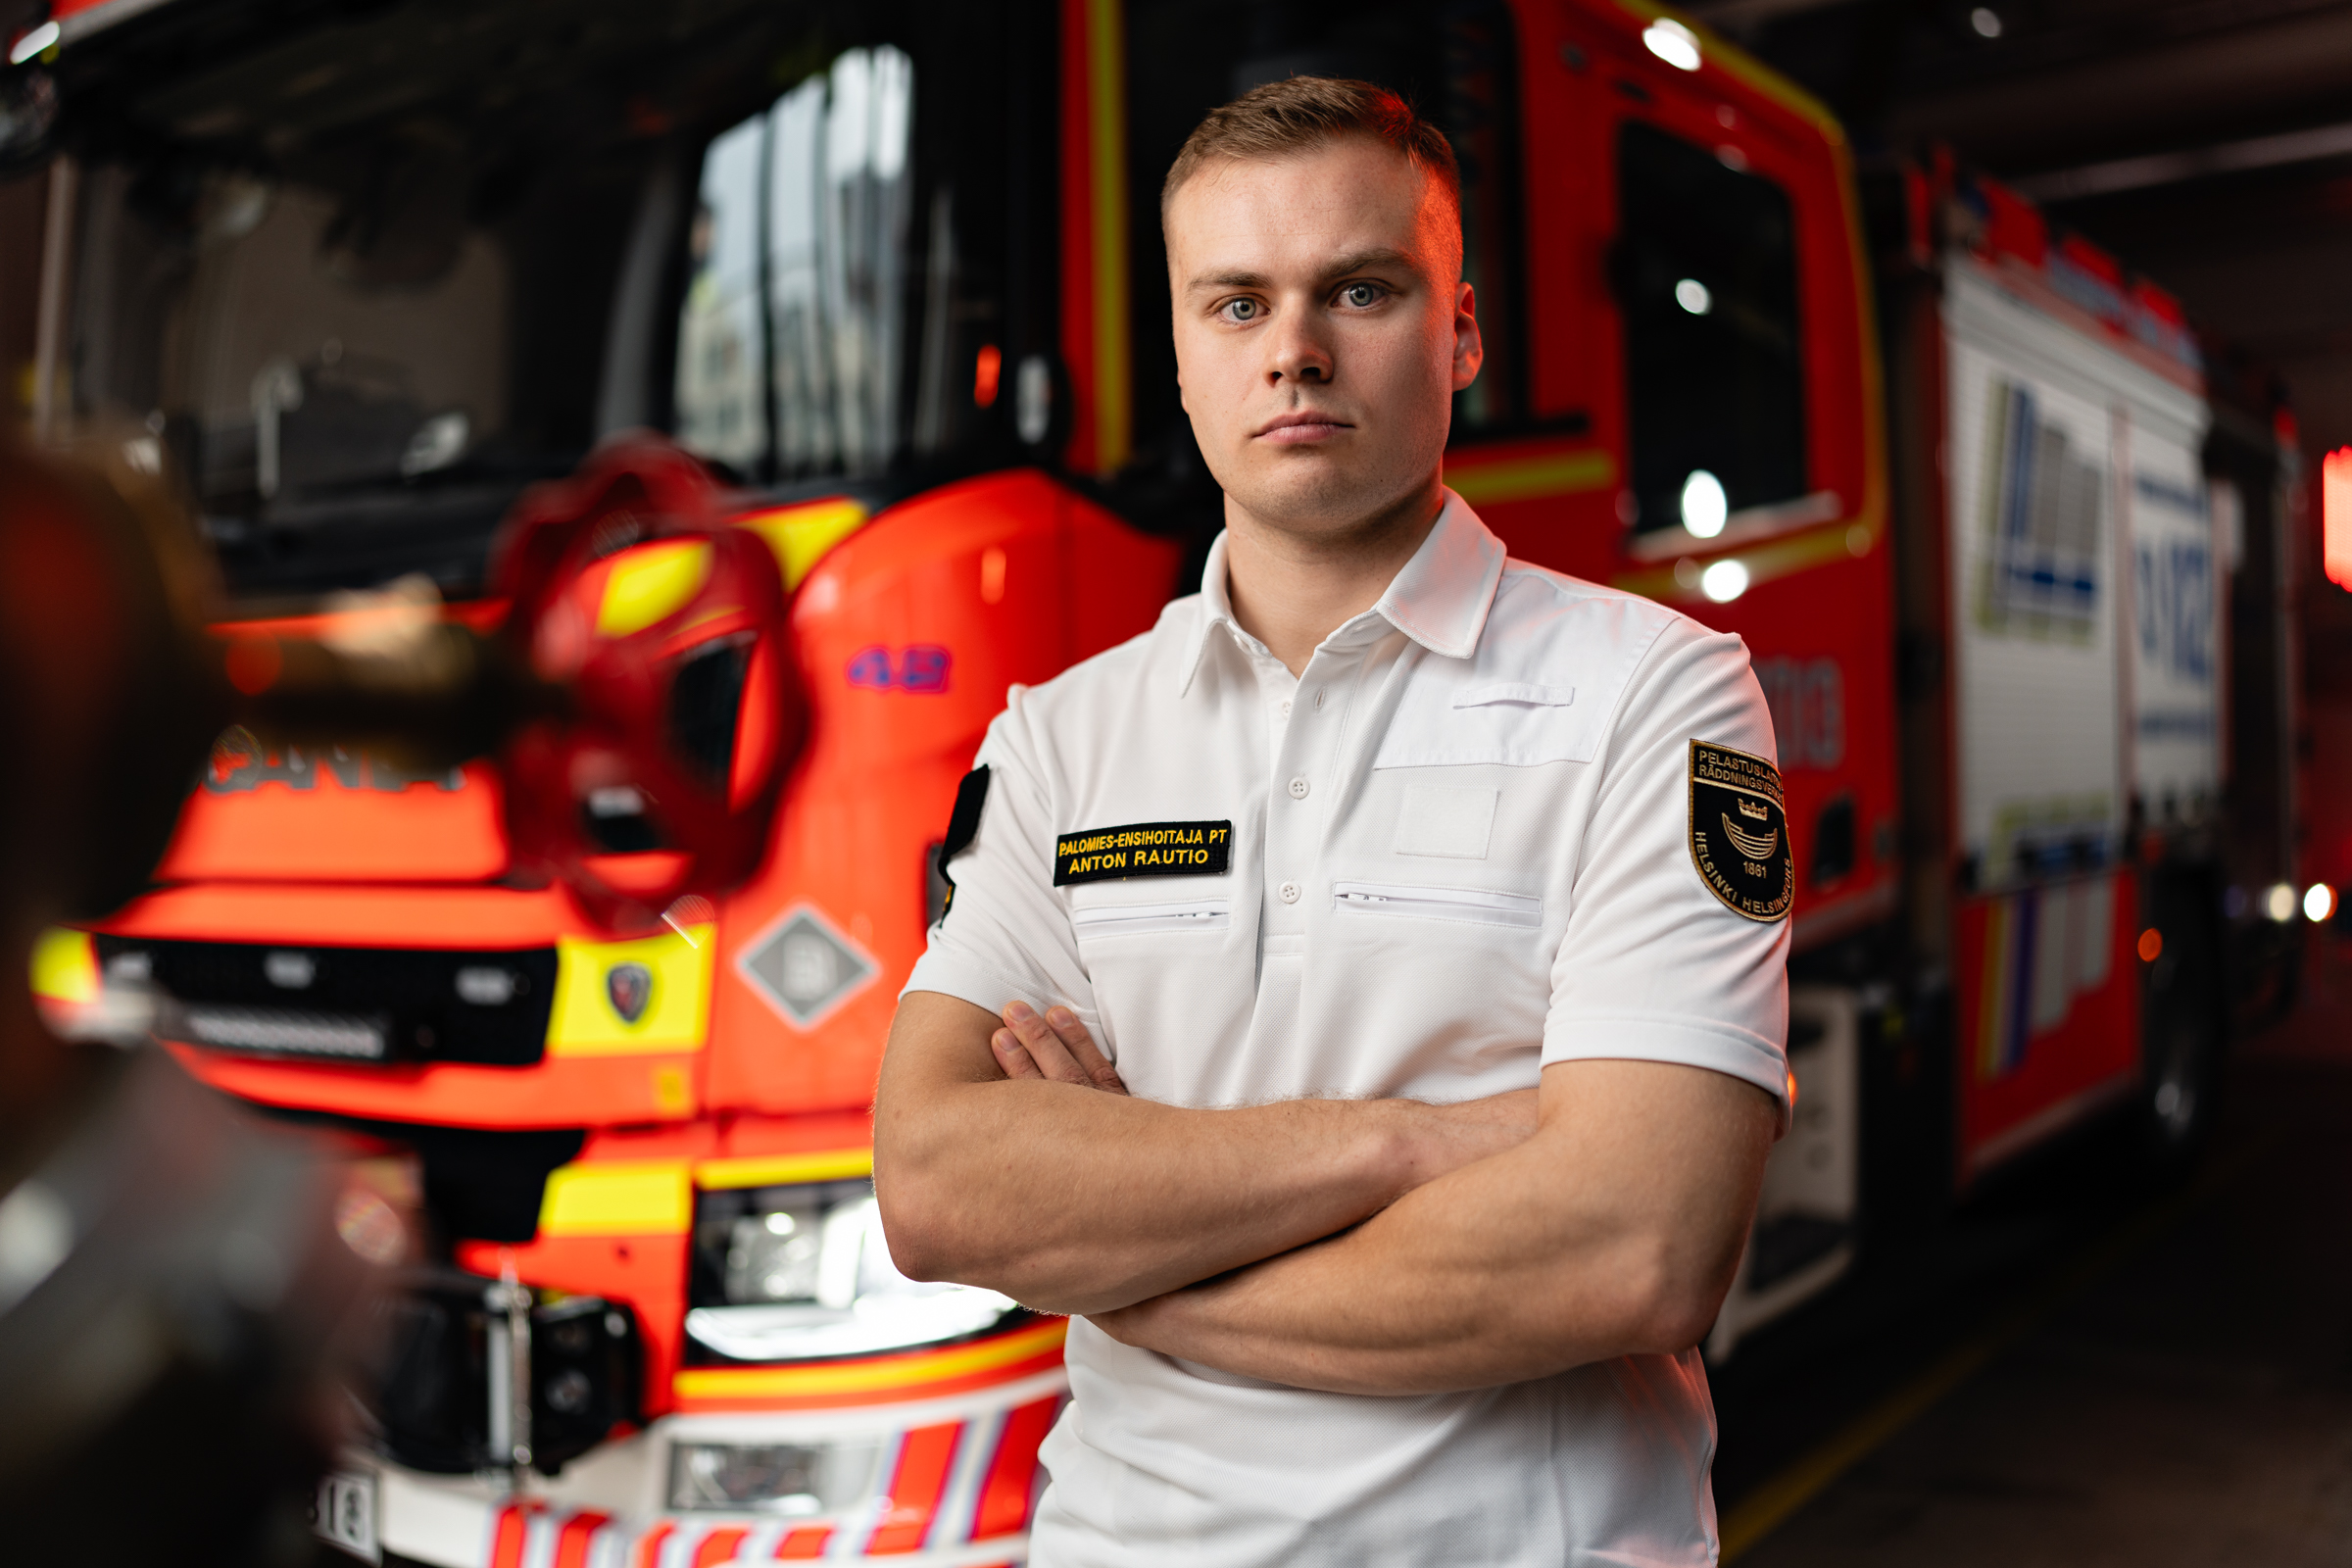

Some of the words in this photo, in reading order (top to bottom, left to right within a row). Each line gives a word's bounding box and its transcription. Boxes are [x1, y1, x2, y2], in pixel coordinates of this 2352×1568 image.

[1058, 829, 1203, 858] PALOMIES-ENSIHOITAJA
[1208, 829, 1228, 845] PT
[1068, 852, 1126, 875] ANTON
[1134, 849, 1209, 866] RAUTIO
[1694, 831, 1738, 903] HELSINKI
[1741, 858, 1791, 914] HELSINGFORS
[1742, 860, 1767, 879] 1861
